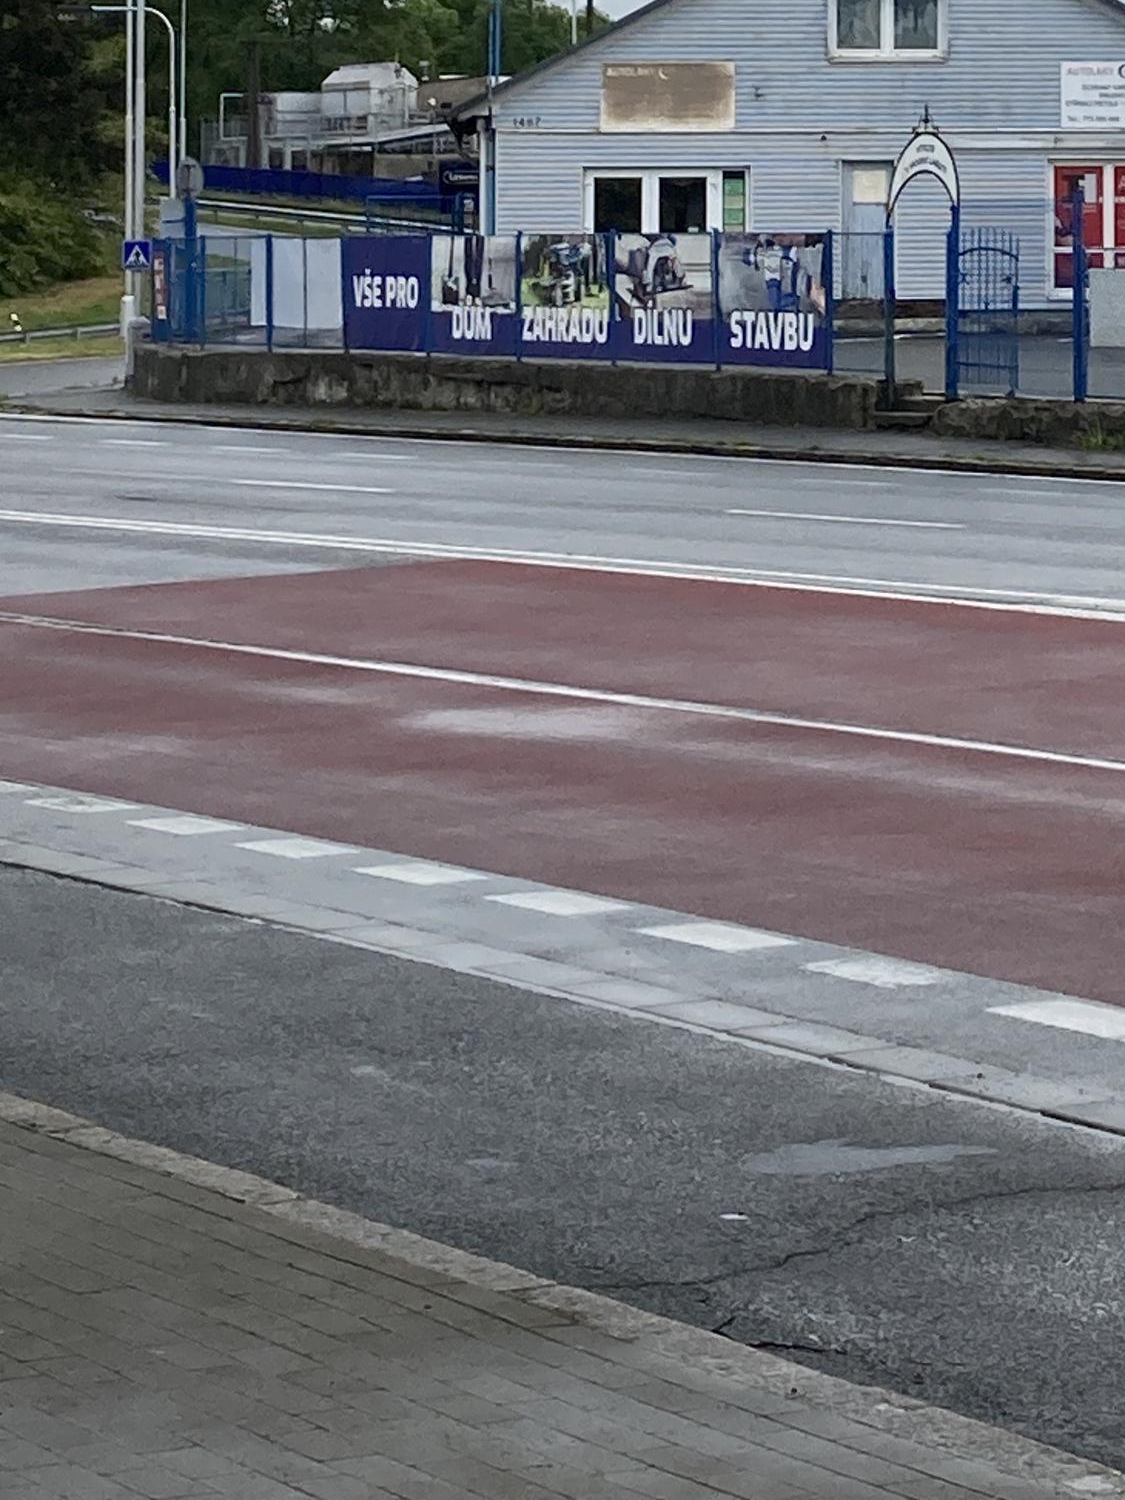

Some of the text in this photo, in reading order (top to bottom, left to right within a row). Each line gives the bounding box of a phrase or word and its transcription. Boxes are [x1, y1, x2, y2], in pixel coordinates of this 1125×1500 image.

[353, 267, 383, 308] VŠE
[385, 275, 419, 309] PRO
[522, 306, 608, 343] ZAHRADU
[633, 300, 693, 346] DÍLNU
[730, 310, 814, 351] STAVBU
